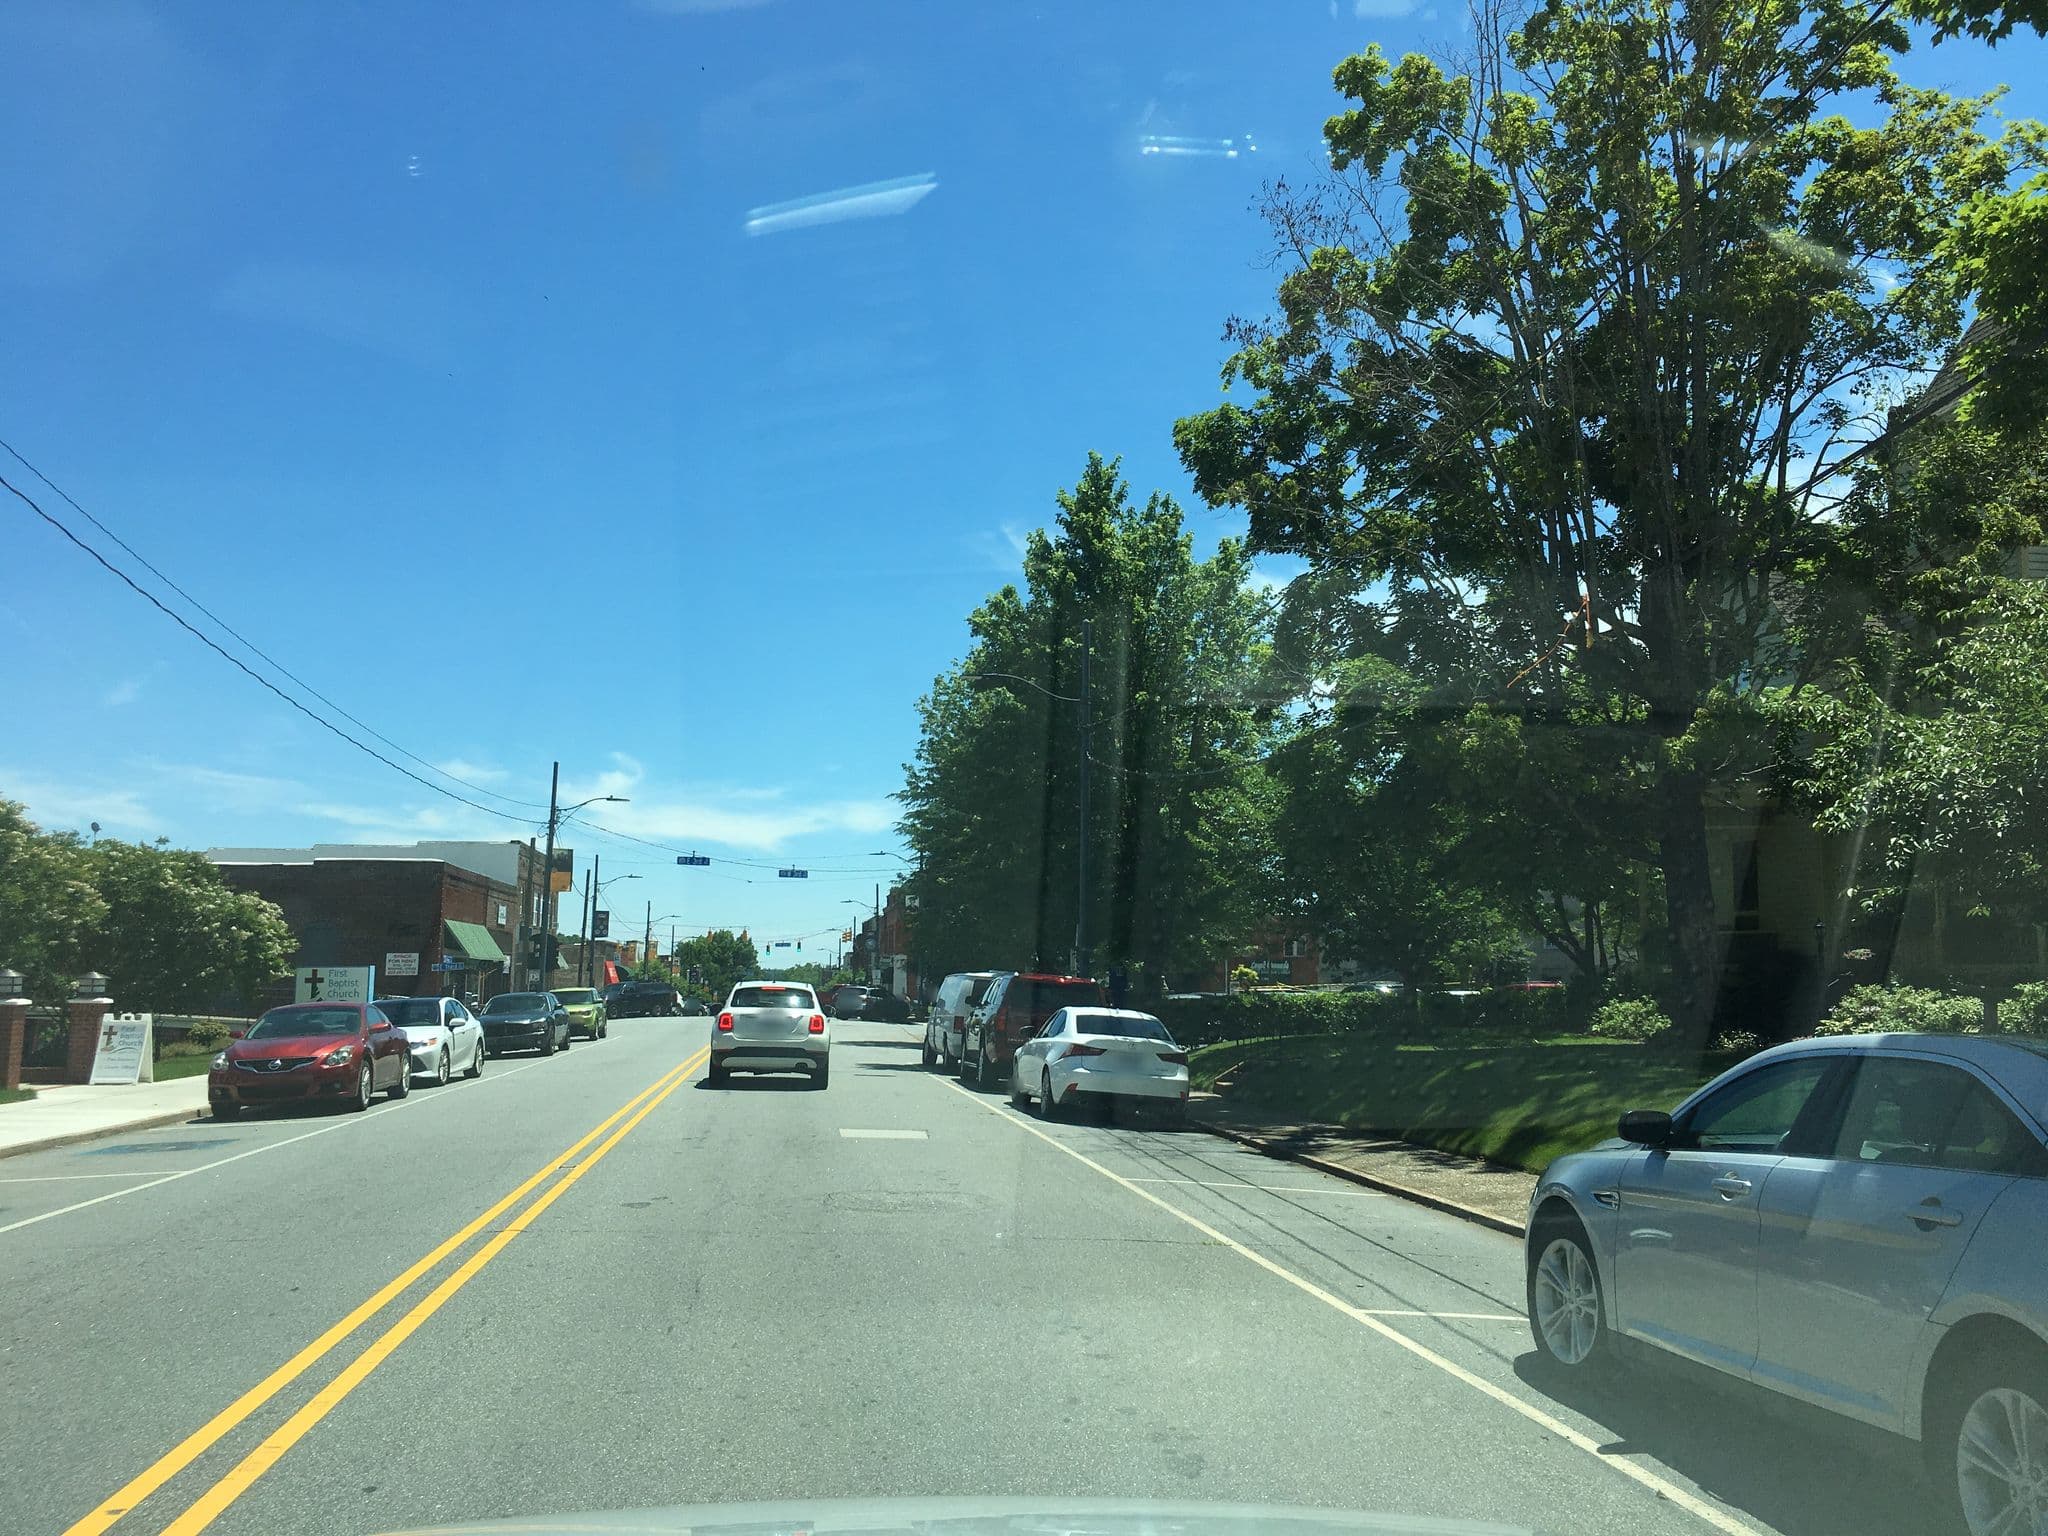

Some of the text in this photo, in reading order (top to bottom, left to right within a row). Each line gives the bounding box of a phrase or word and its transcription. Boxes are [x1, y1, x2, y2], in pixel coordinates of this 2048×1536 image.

[328, 969, 348, 978] First
[328, 979, 360, 990] Baptist
[327, 988, 360, 998] Church
